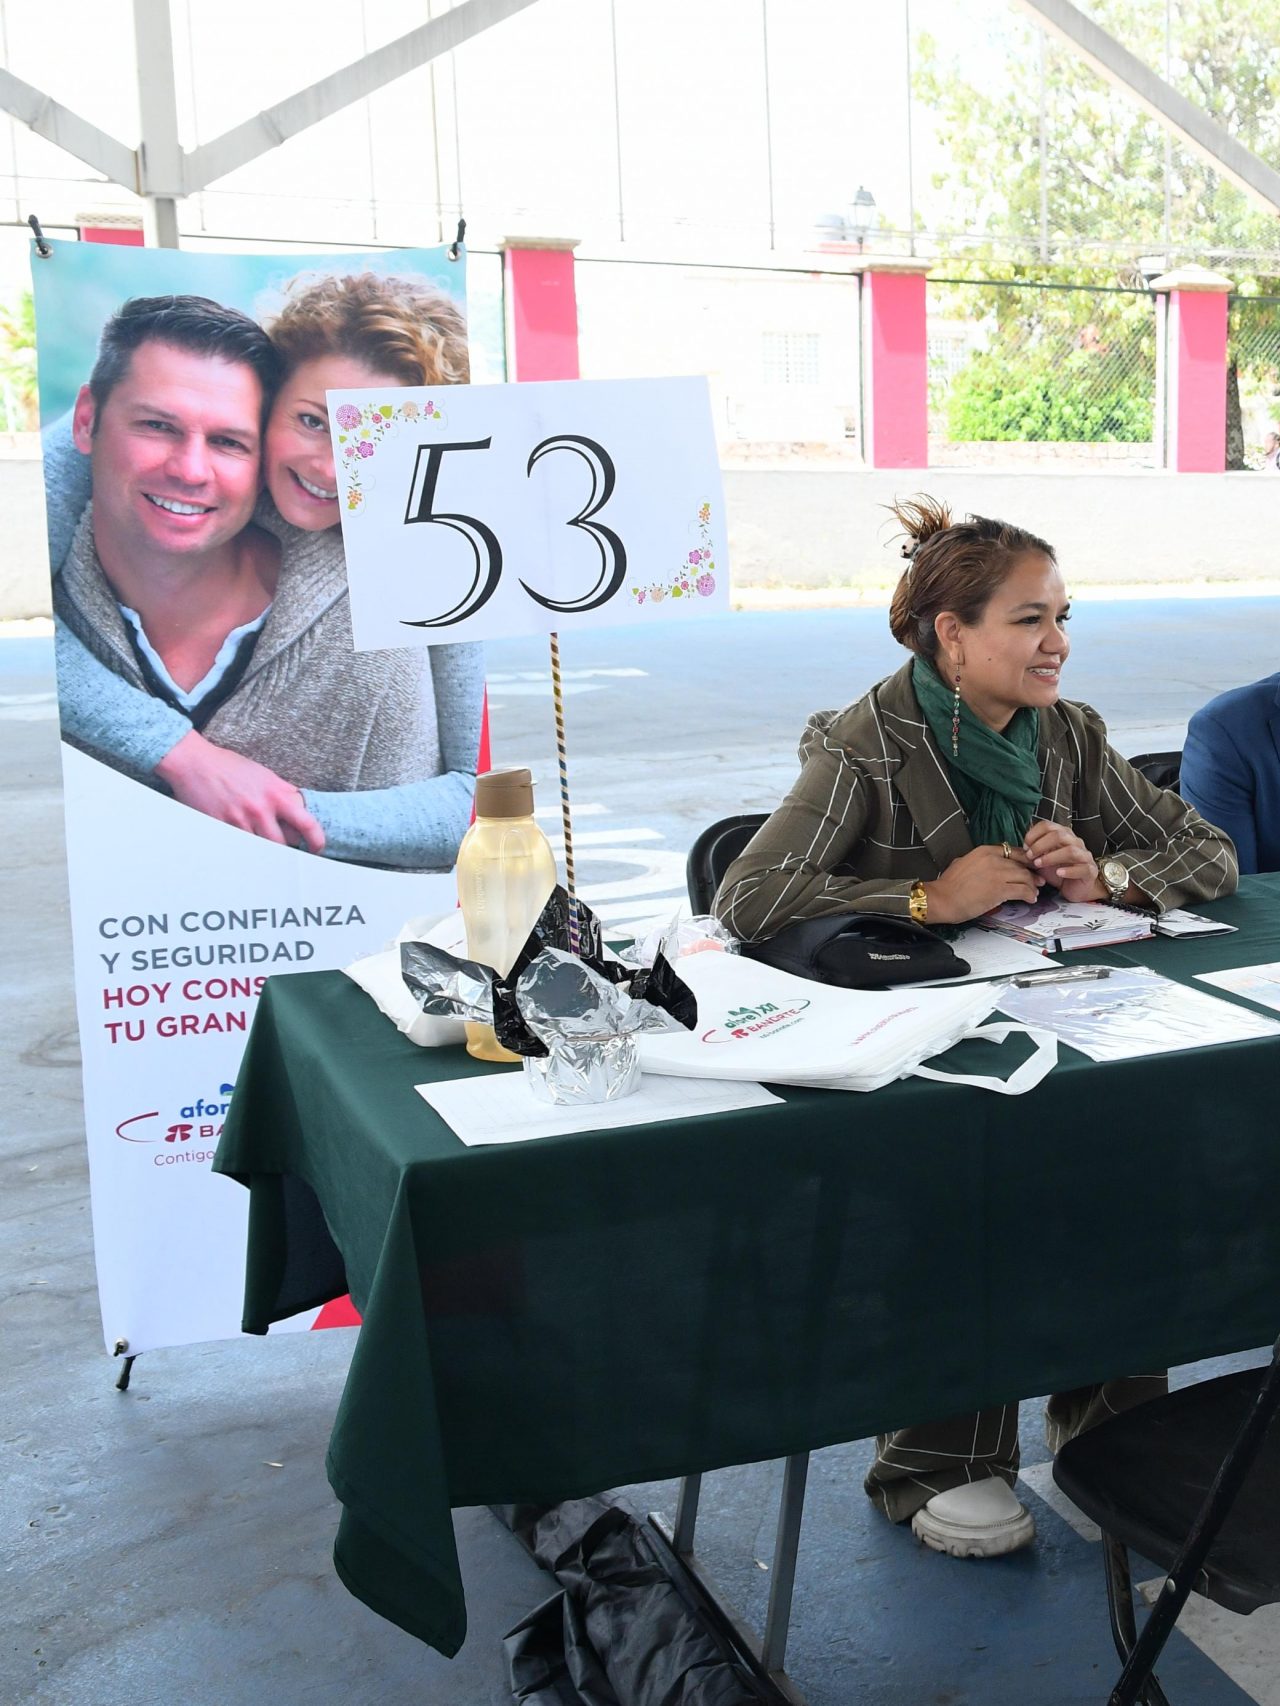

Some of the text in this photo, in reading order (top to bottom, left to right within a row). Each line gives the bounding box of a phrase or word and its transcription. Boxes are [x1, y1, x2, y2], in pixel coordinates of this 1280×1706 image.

[398, 434, 628, 628] 53
[98, 904, 366, 940] CON CONFIANZA
[100, 940, 315, 975] Y SEGURIDAD
[103, 982, 172, 1010] HOY
[103, 1010, 247, 1044] TU GRAN
[154, 1149, 216, 1167] Contigo
